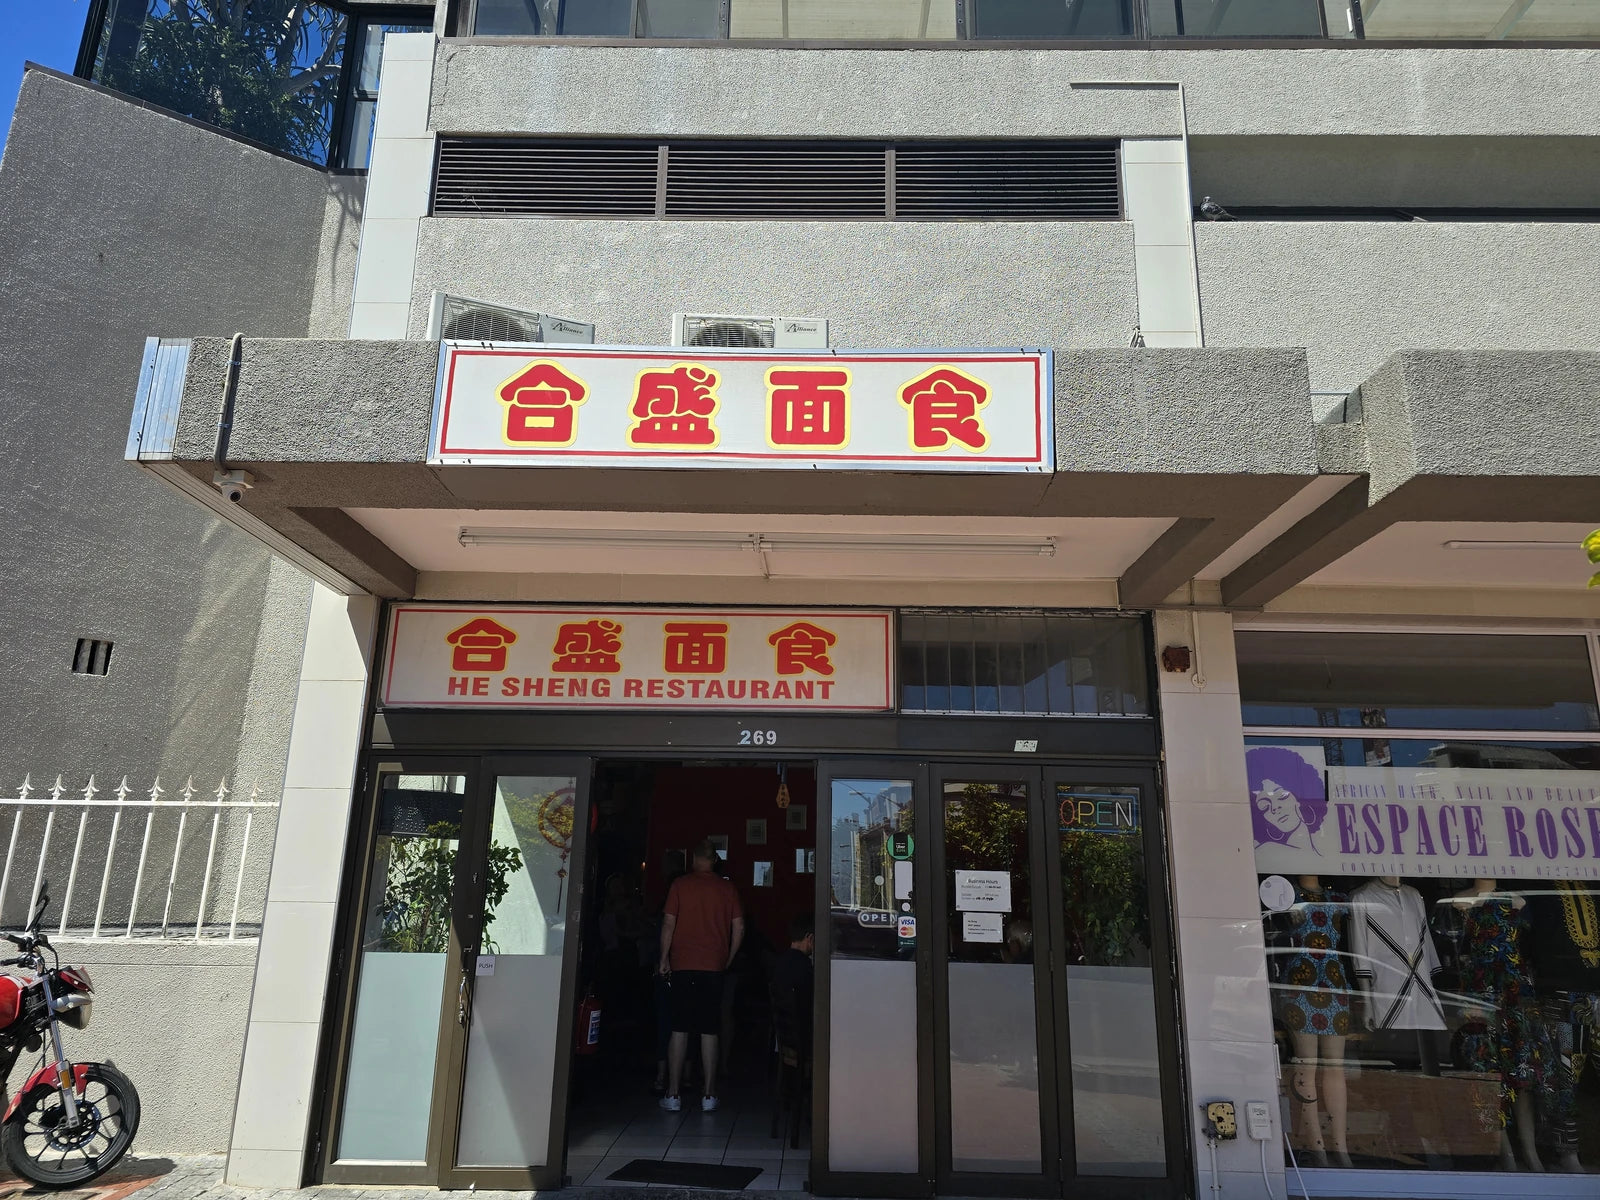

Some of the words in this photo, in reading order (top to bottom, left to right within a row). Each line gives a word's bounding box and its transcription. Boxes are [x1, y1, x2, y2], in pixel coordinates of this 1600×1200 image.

[551, 322, 584, 334] Alliance
[785, 323, 818, 333] Alliance
[495, 359, 993, 454] 合盛面食
[446, 616, 838, 677] 合盛面食
[447, 675, 489, 697] HE
[501, 677, 611, 699] SHENG
[622, 678, 835, 701] RESTAURANT
[739, 730, 778, 746] 269
[1335, 784, 1386, 798] AFRICAN
[1456, 785, 1493, 801] NAIL
[1506, 787, 1534, 801] AND
[1059, 800, 1132, 827] OPEN
[1334, 803, 1488, 857] ESPACE
[1341, 862, 1405, 874] CONTACT
[861, 913, 898, 923] OPEN
